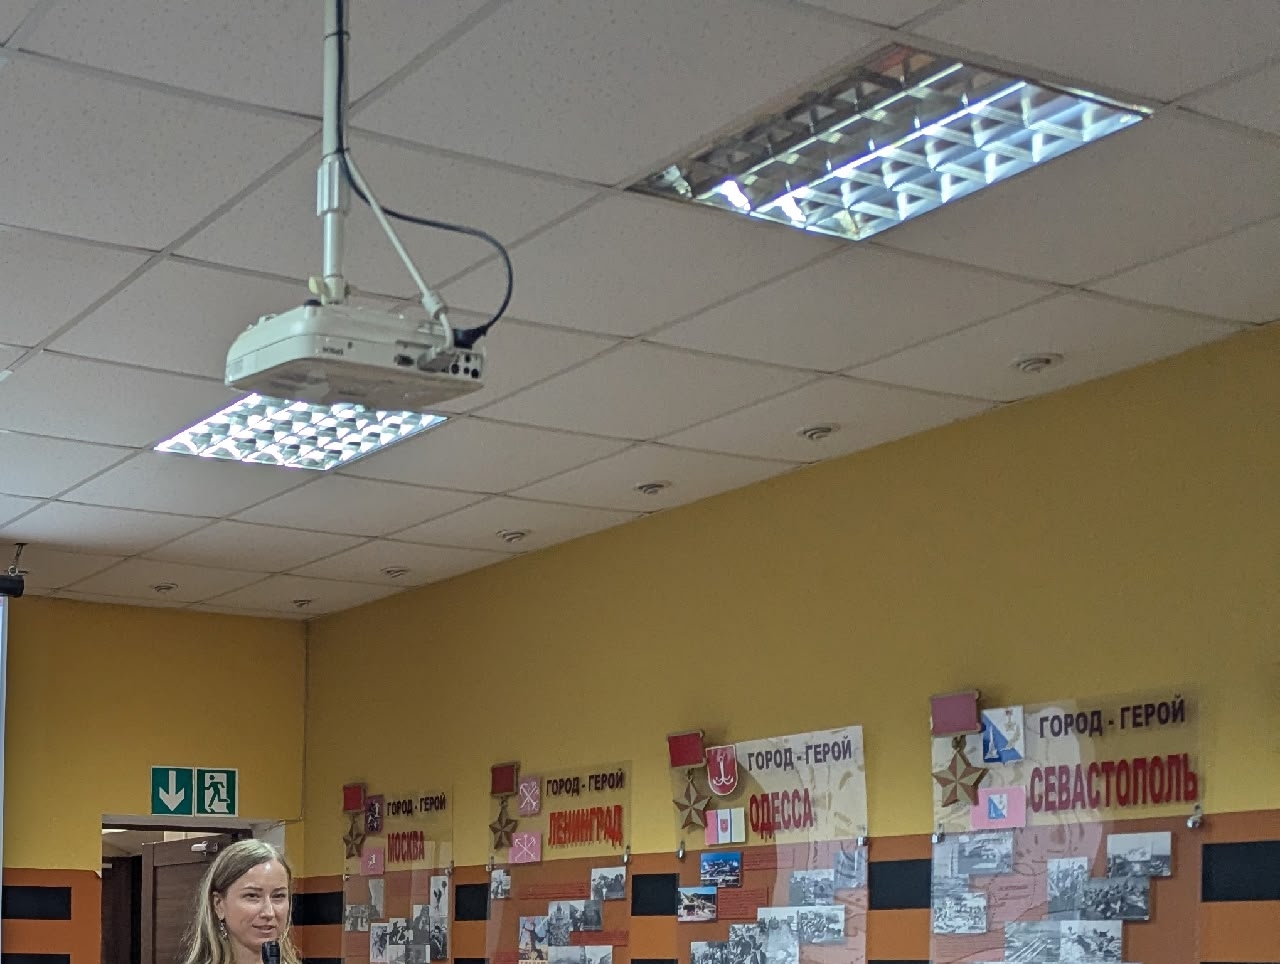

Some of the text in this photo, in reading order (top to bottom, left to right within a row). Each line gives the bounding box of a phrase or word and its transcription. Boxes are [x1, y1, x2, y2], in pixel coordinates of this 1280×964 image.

[1039, 710, 1103, 738] ГОРОД
[1120, 693, 1185, 729] ГЕРОЙ
[747, 747, 794, 772] ГОРОД
[805, 735, 852, 766] ГЕРОЙ
[546, 776, 581, 797] ГОРОД
[588, 768, 624, 792] ГЕРОЙ
[1029, 753, 1198, 812] СЕВАСТОПОЛЬ
[387, 799, 413, 816] ГОРОД
[420, 792, 446, 813] ГЕРОЙ
[749, 788, 814, 839] ОДЕССА
[548, 804, 624, 847] ЛЕНИНГРАД
[387, 830, 425, 864] МОСКВА
